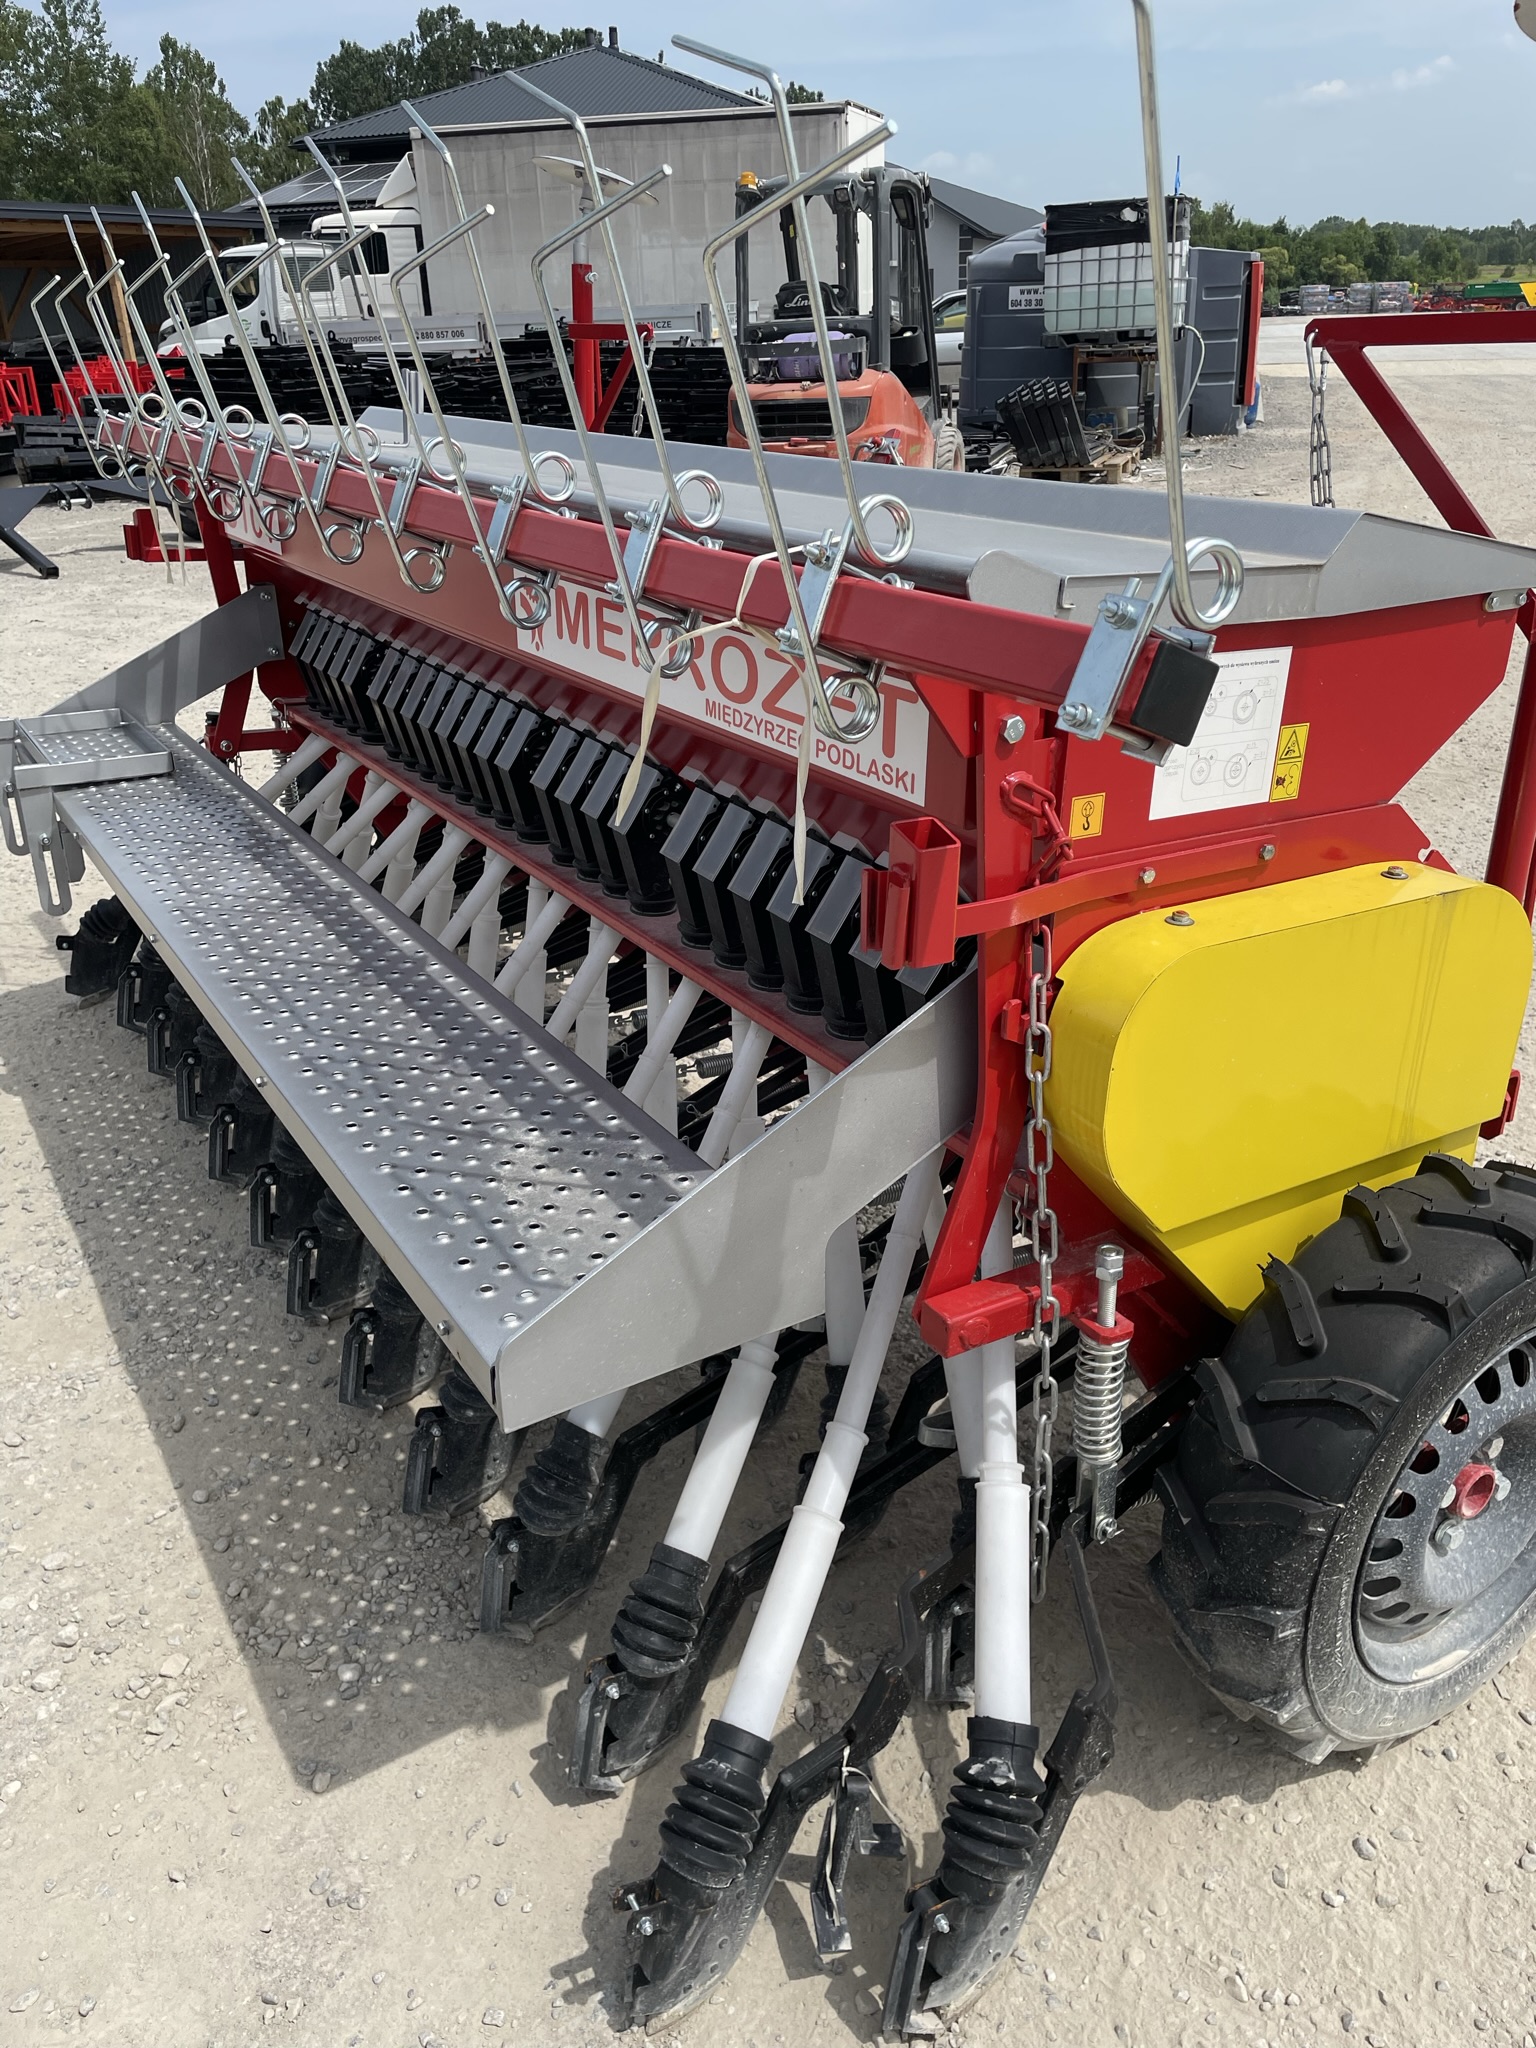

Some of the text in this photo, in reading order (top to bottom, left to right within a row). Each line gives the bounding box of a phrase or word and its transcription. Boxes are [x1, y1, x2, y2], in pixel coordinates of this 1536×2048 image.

[1020, 288, 1045, 296] www.
[784, 293, 811, 308] Lin
[1010, 298, 1043, 308] 604 38 30
[420, 331, 434, 340] 880
[435, 330, 449, 339] 857
[451, 329, 465, 338] 006
[705, 698, 916, 795] MIĘDZYRZE PODLASKI
